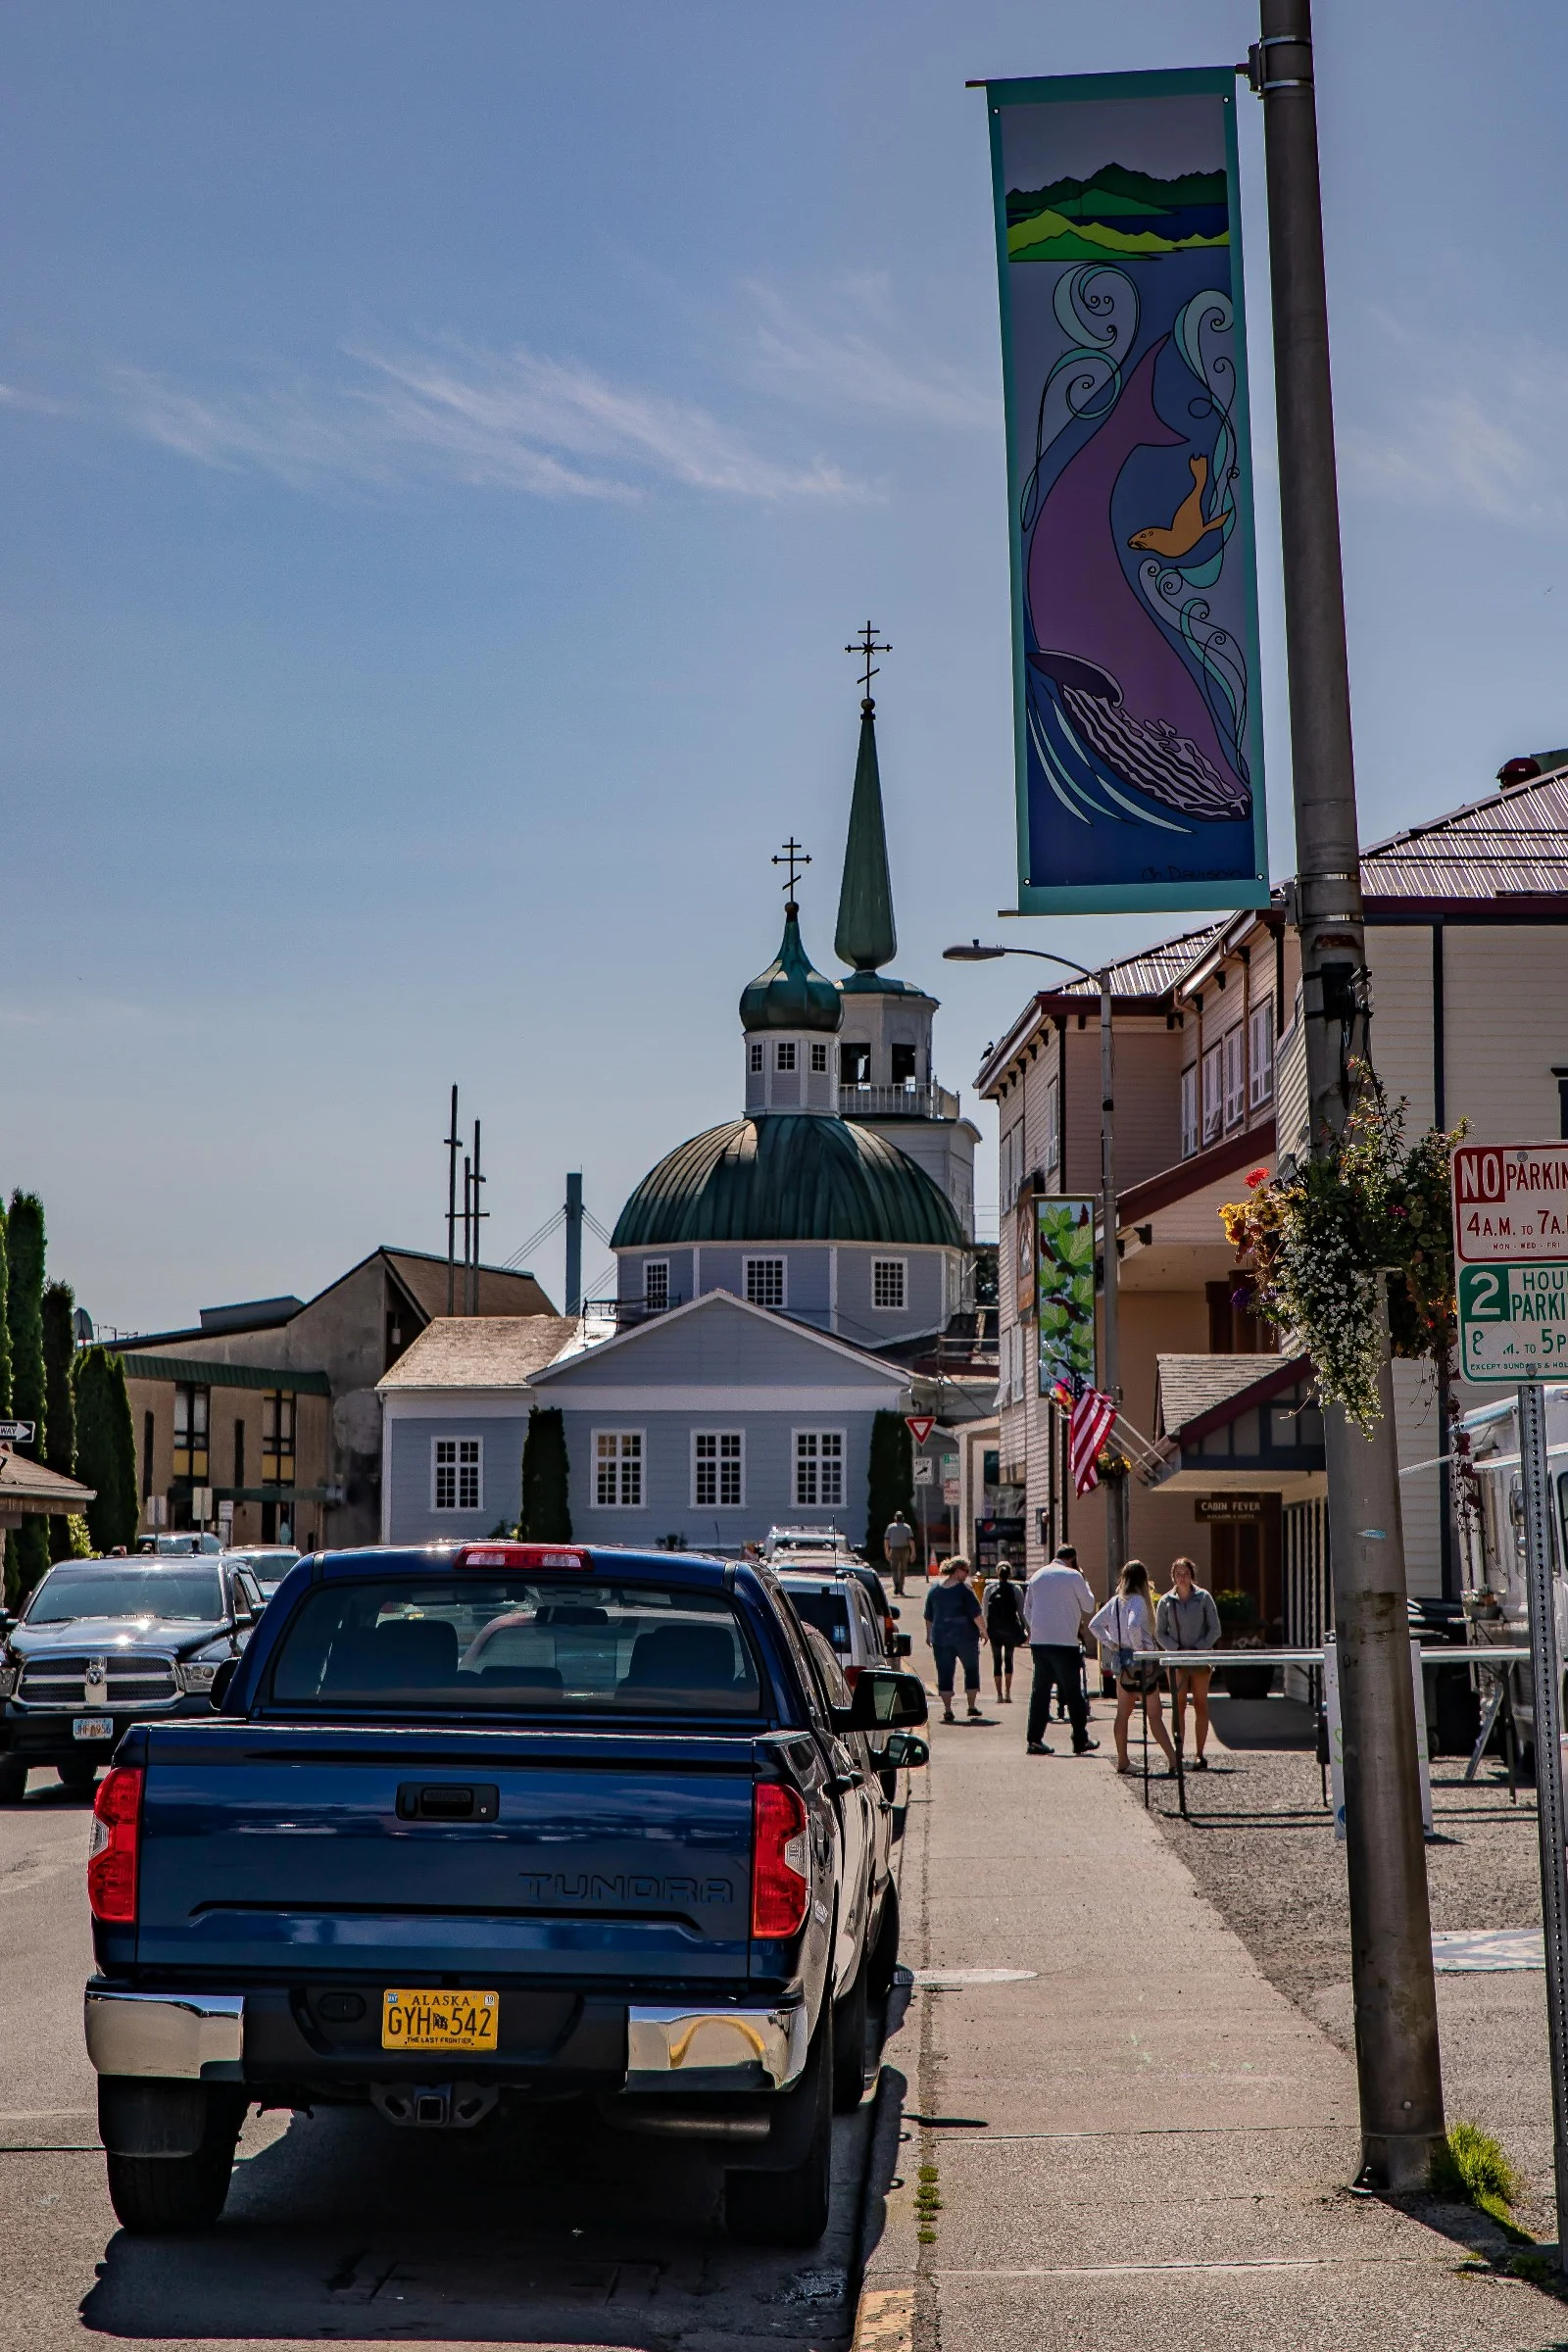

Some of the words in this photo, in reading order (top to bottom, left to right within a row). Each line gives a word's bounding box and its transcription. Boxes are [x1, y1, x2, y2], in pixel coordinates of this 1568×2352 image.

[1460, 1153, 1500, 1198] NO
[1466, 1211, 1516, 1237] 4A.M.
[1521, 1225, 1534, 1236] TO
[1537, 1209, 1568, 1235] 7A.
[1470, 1271, 1501, 1316] 2
[1522, 1270, 1568, 1291] HOU
[1524, 1344, 1537, 1354] TO
[1200, 1501, 1228, 1511] CABIN
[1232, 1501, 1261, 1511] FEVER
[518, 1873, 734, 1904] TUNDRA
[411, 1995, 470, 2006] ALASKA
[388, 2006, 431, 2035] GYH
[450, 2007, 492, 2037] 542
